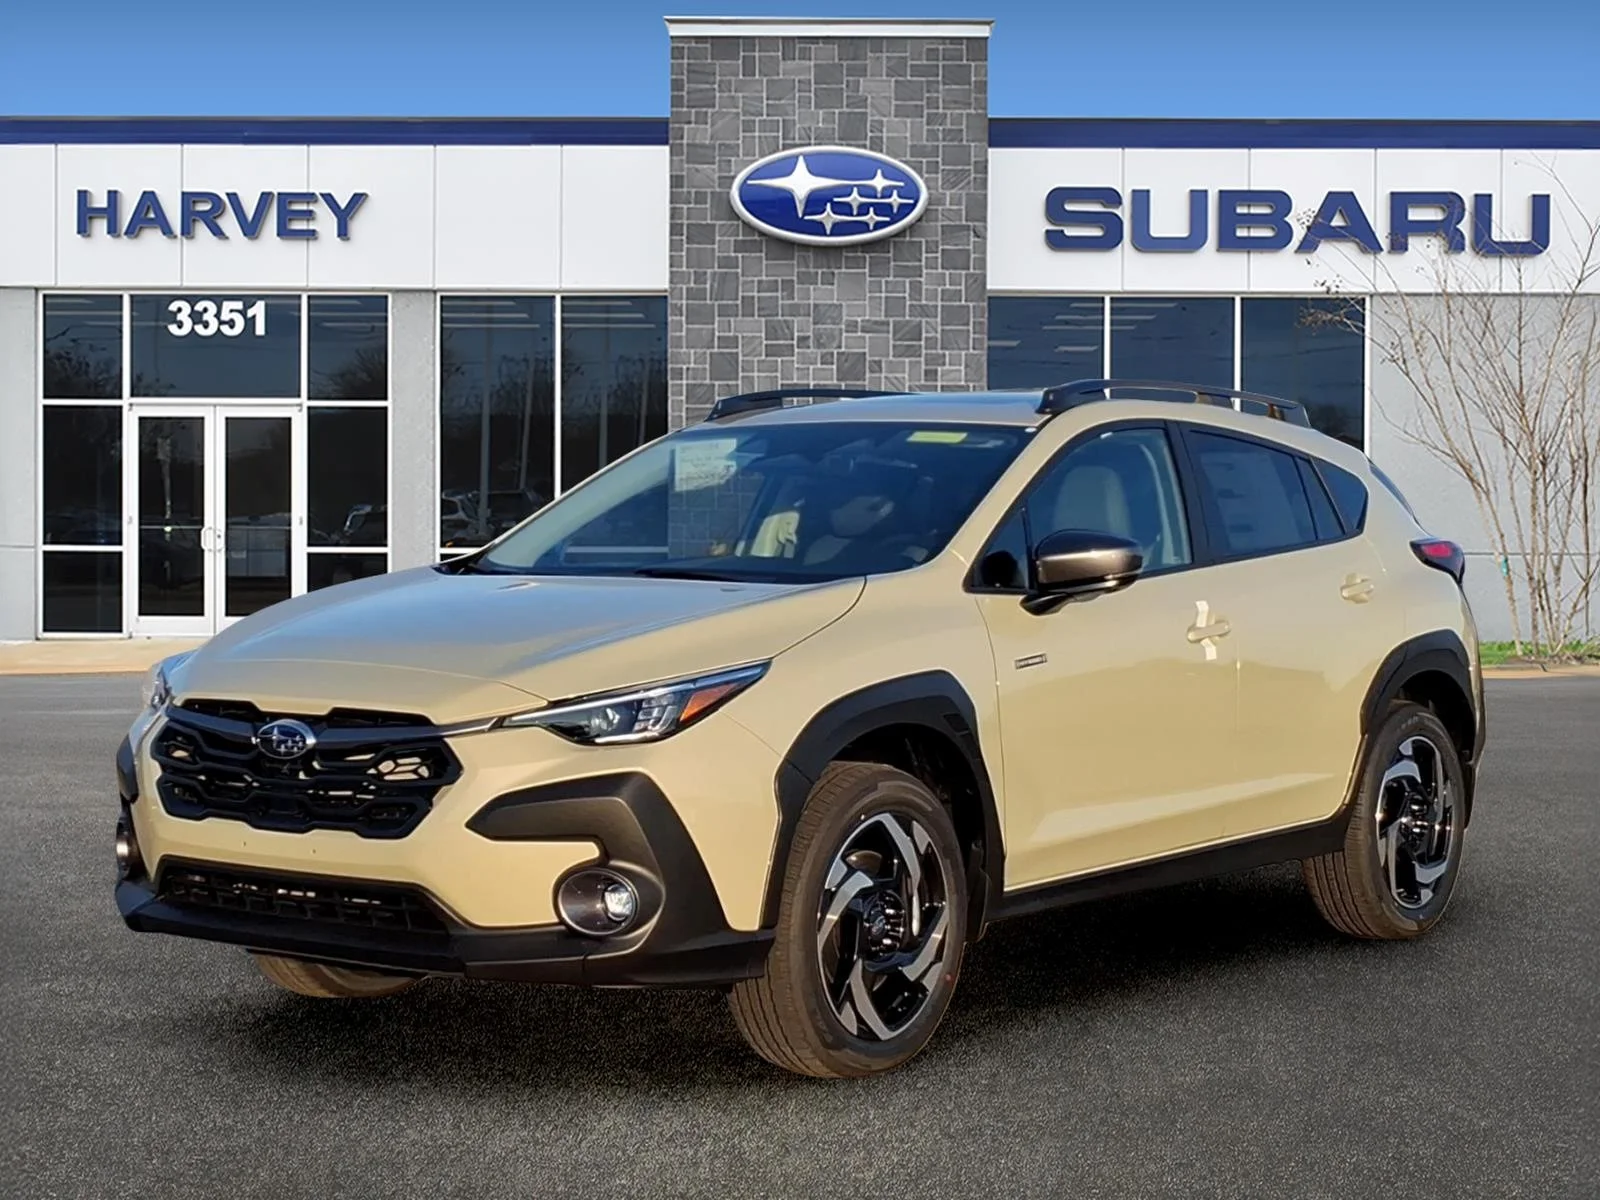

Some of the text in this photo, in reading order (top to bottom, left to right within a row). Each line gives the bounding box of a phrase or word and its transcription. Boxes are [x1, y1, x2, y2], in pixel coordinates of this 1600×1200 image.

[76, 189, 367, 240] HARVEY
[1044, 186, 1551, 257] SUBARU
[167, 300, 267, 337] 3351
